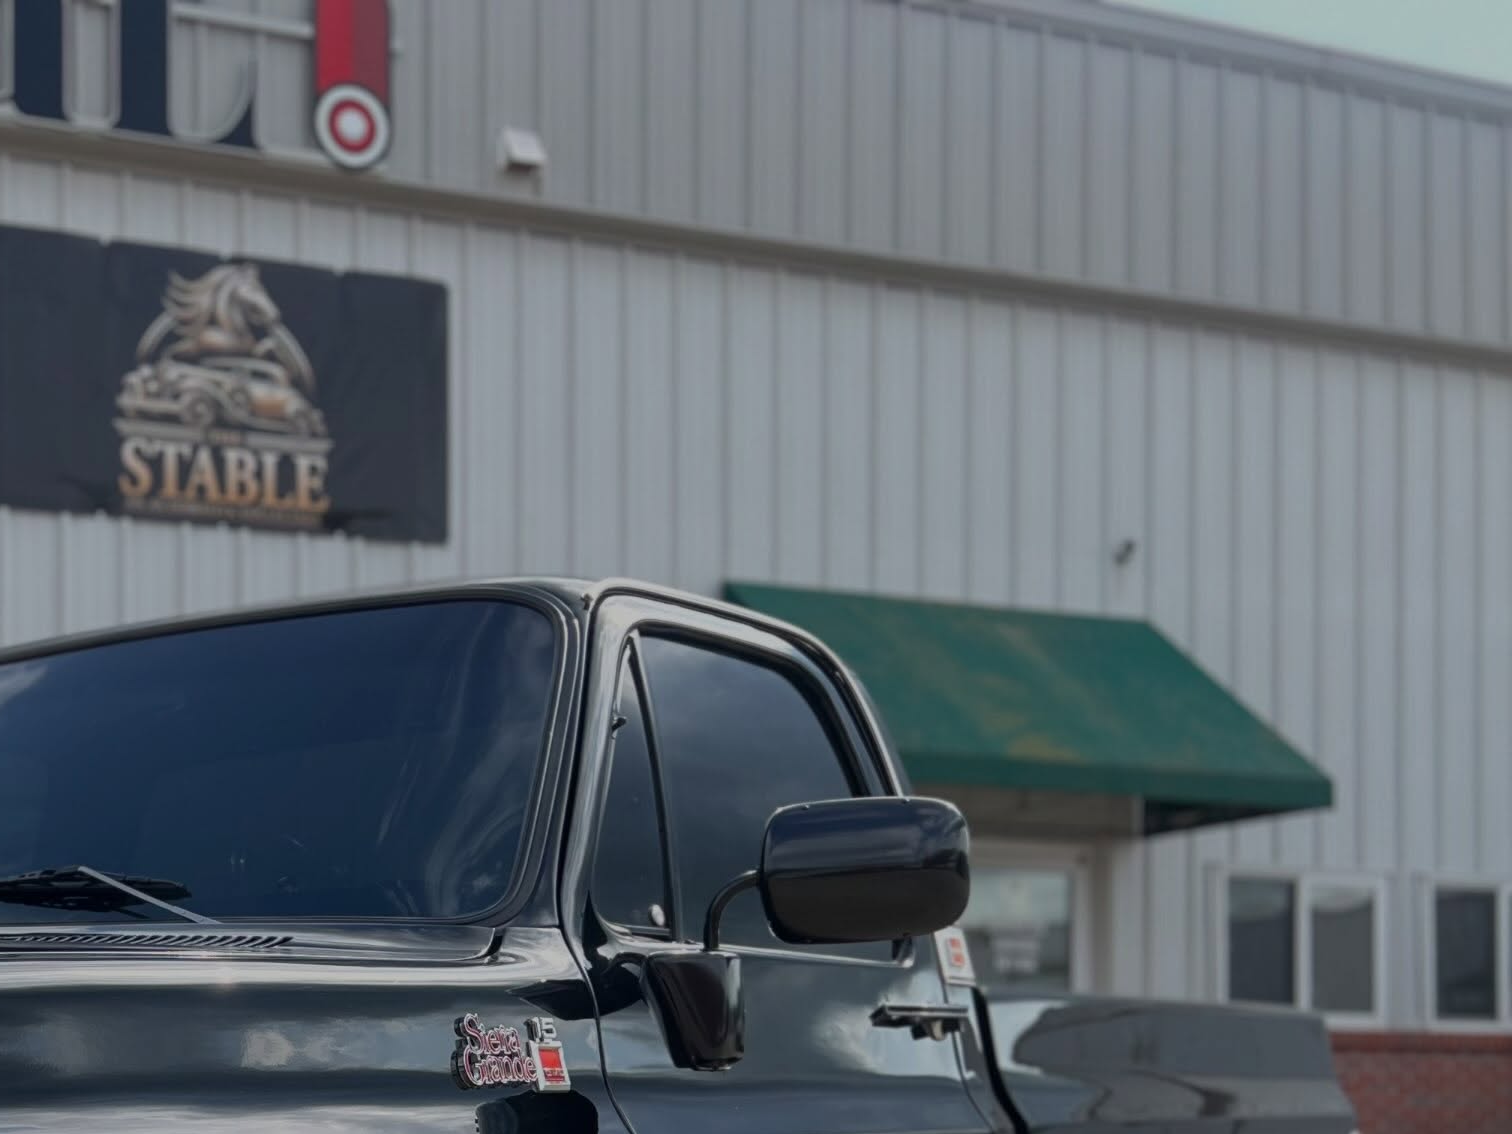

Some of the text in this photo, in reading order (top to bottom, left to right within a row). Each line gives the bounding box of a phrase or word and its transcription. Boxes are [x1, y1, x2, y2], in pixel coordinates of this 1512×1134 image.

[118, 437, 330, 513] STABLE
[463, 1013, 521, 1055] Sierra
[526, 1017, 557, 1040] 15
[463, 1046, 538, 1086] Grande
